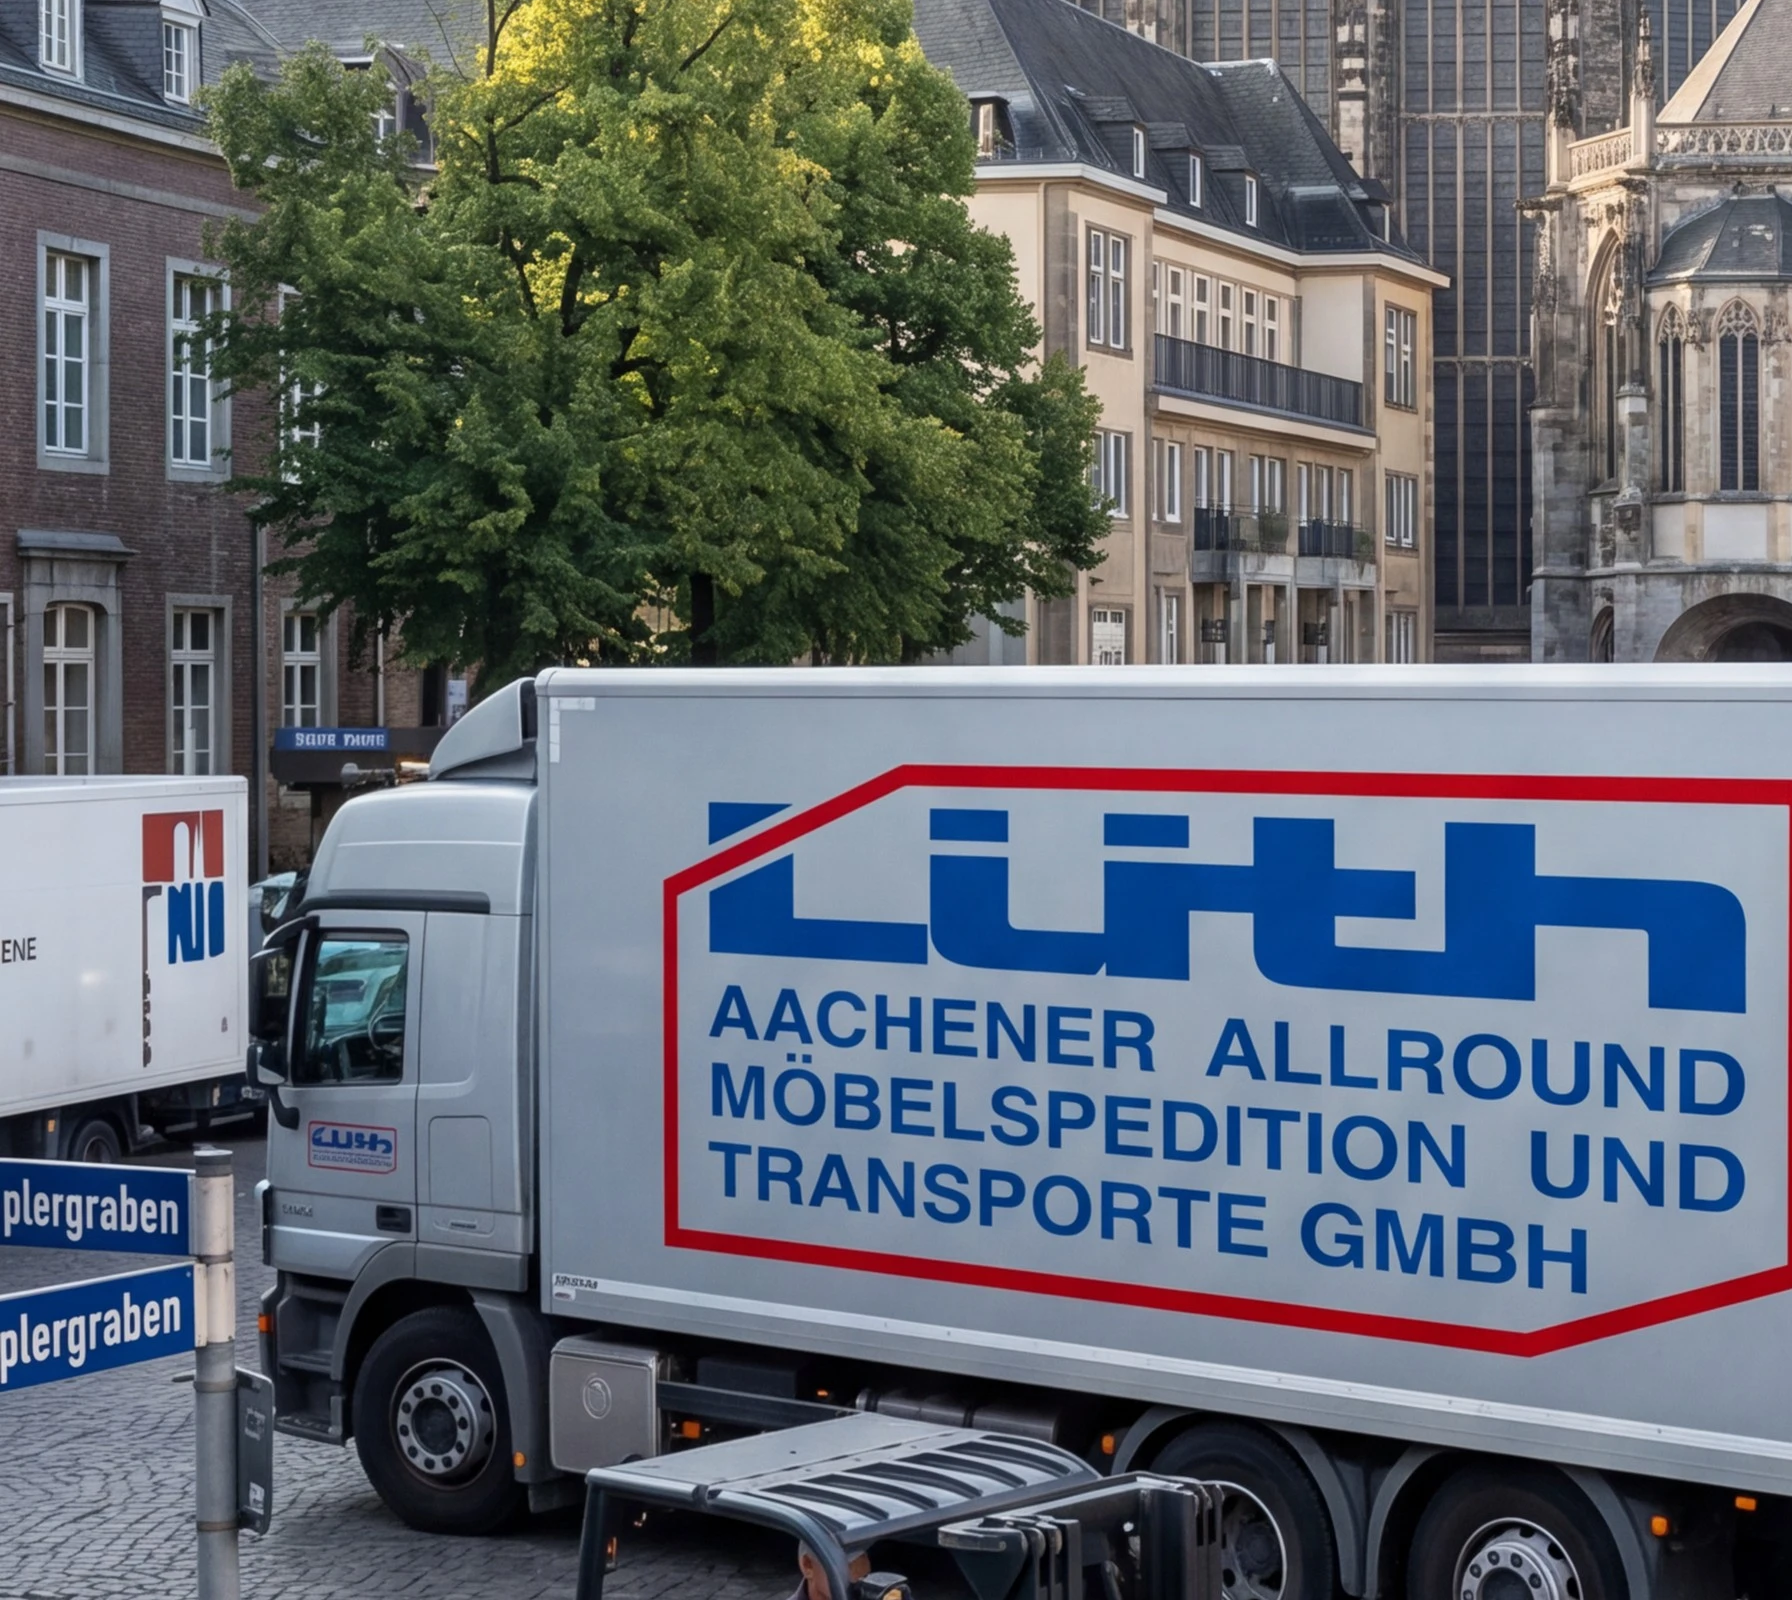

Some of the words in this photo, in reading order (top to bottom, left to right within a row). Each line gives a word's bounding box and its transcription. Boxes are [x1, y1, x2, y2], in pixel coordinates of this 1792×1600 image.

[708, 801, 1747, 1014] Lüth
[709, 984, 1156, 1073] AACHENER
[1205, 1018, 1747, 1117] ALLROUND
[710, 1051, 1467, 1190] MÖBELSPEDITION
[1530, 1131, 1747, 1214] UND
[708, 1140, 1269, 1259] TRANSPORTE
[1300, 1205, 1590, 1295] GMBH
